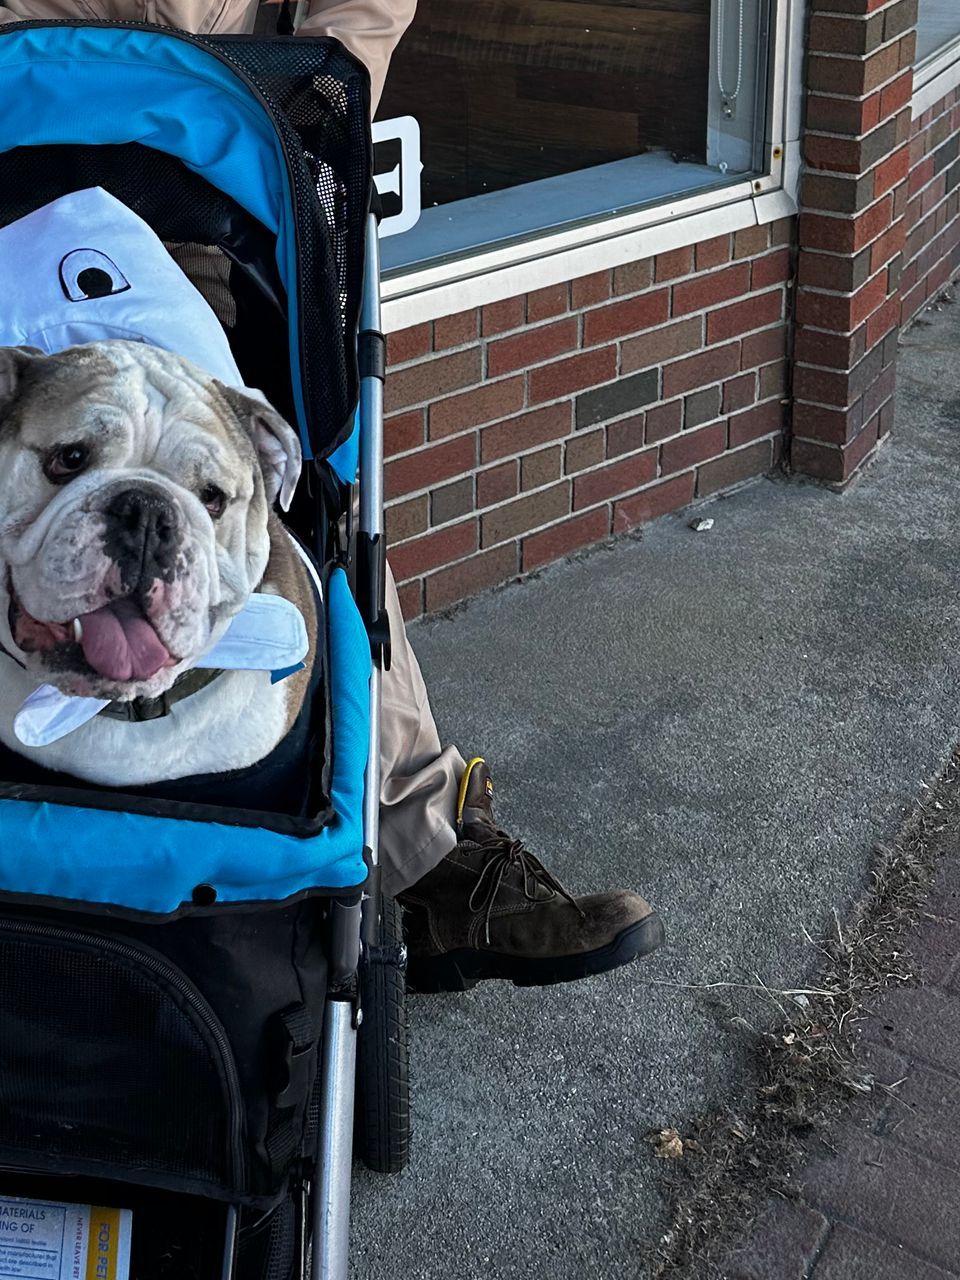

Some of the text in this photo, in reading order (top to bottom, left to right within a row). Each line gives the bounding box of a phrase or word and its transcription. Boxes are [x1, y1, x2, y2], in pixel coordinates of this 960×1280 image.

[20, 1221, 36, 1234] OF
[98, 1223, 110, 1252] FOR
[74, 1242, 82, 1265] LEAVE
